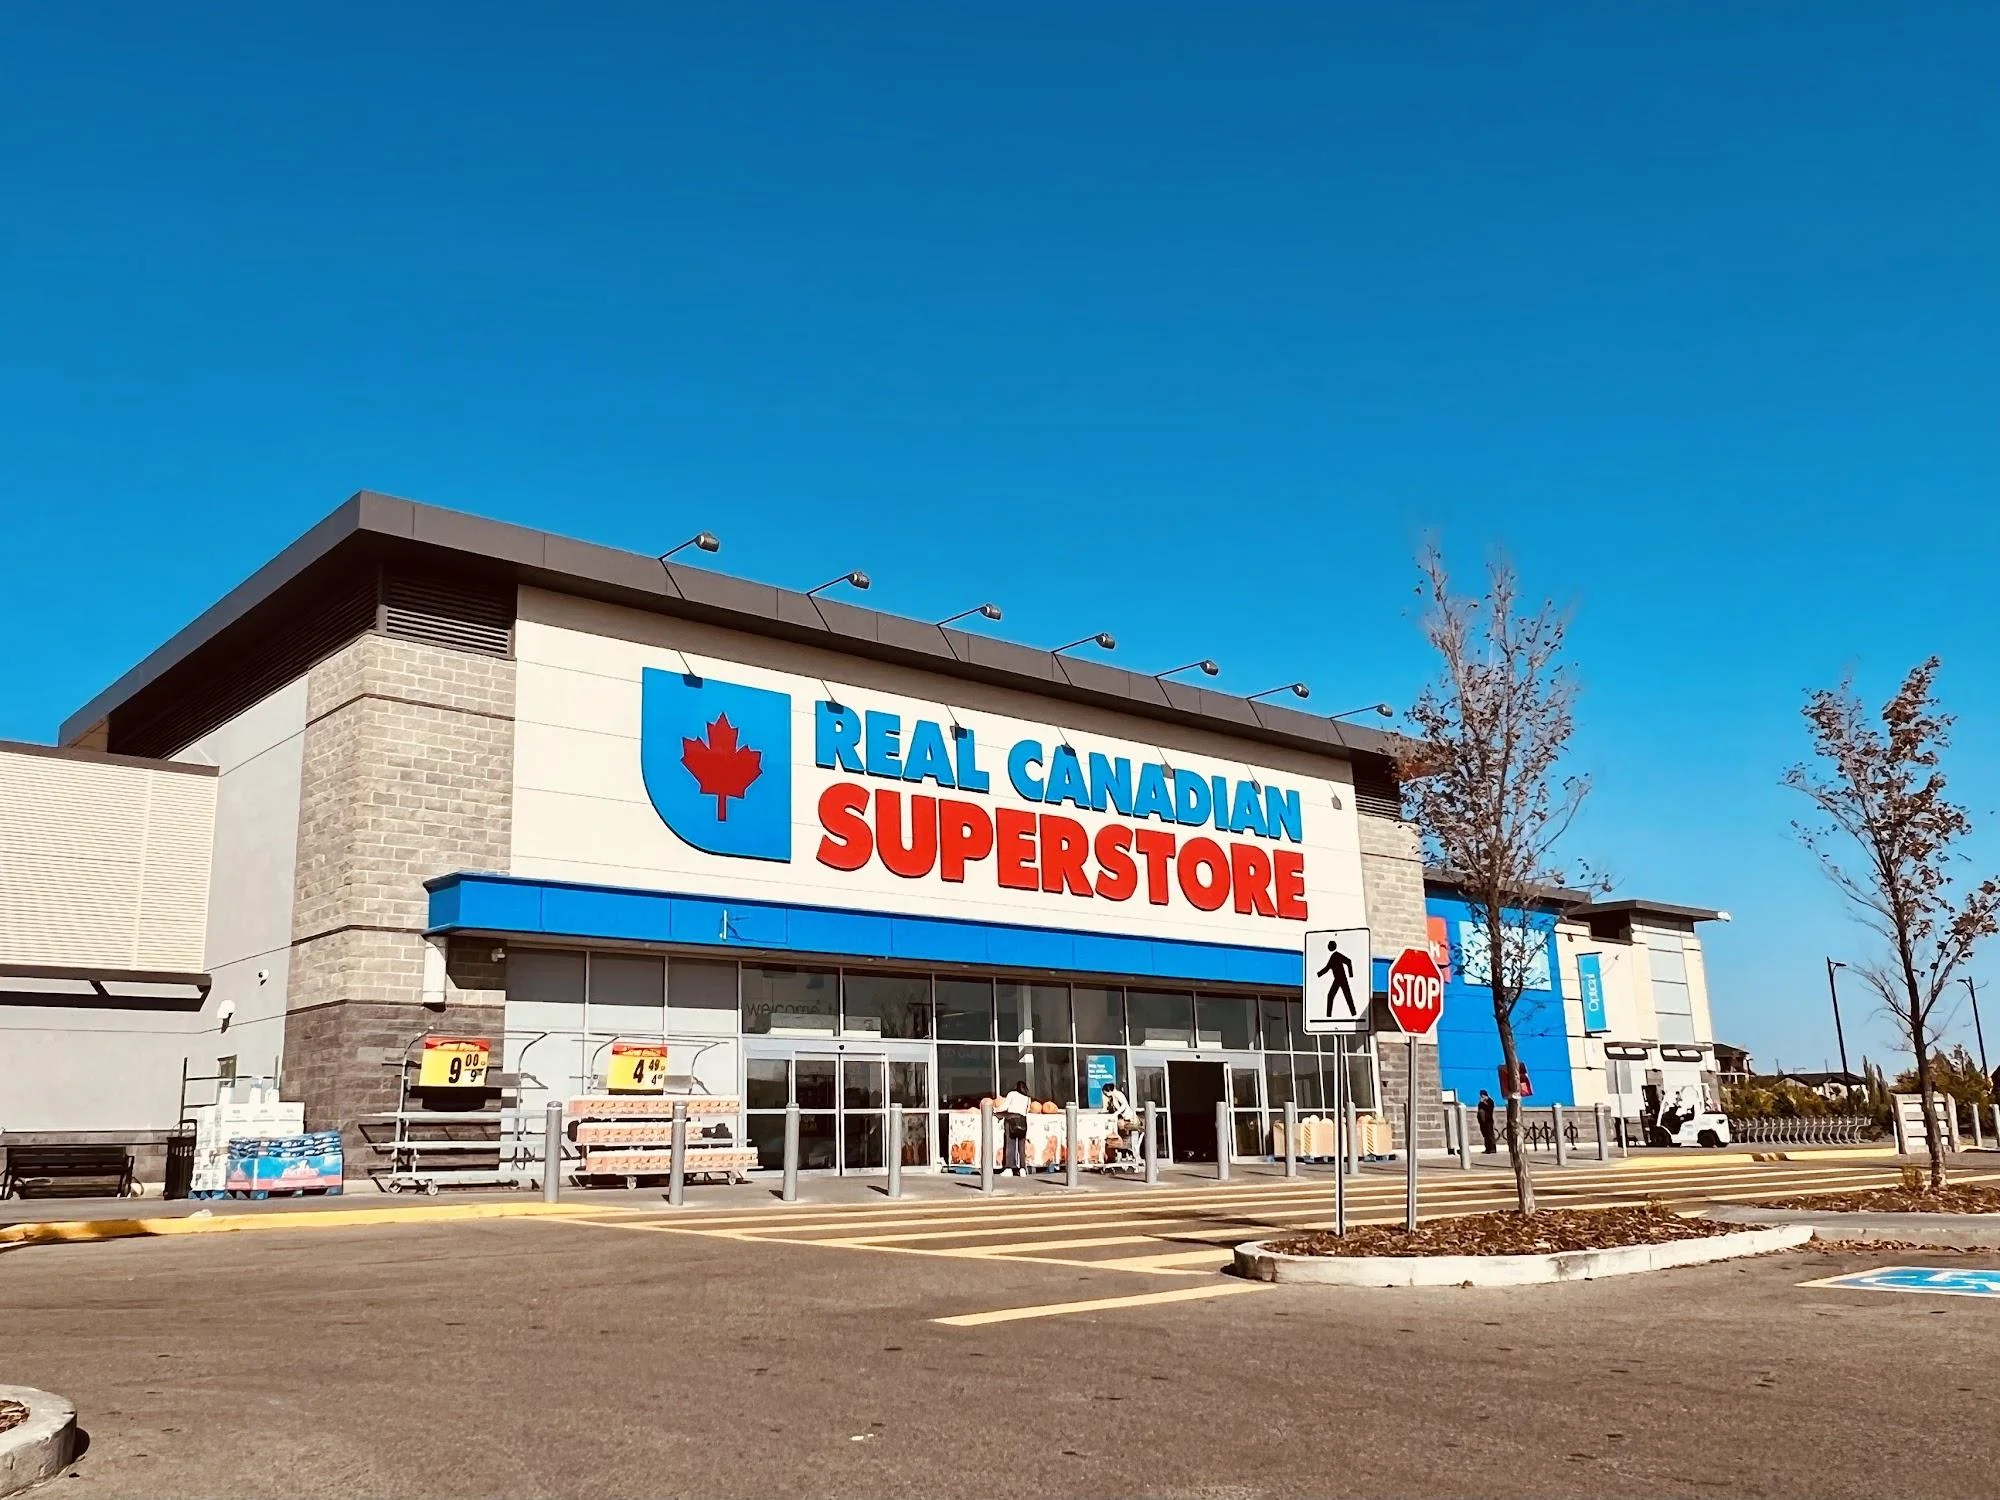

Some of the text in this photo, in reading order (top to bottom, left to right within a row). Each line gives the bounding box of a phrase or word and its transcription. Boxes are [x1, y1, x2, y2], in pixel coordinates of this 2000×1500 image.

[815, 701, 1302, 843] REAL CANADIAN
[816, 783, 1307, 921] SUPERSTORE
[1392, 972, 1440, 1010] STOP
